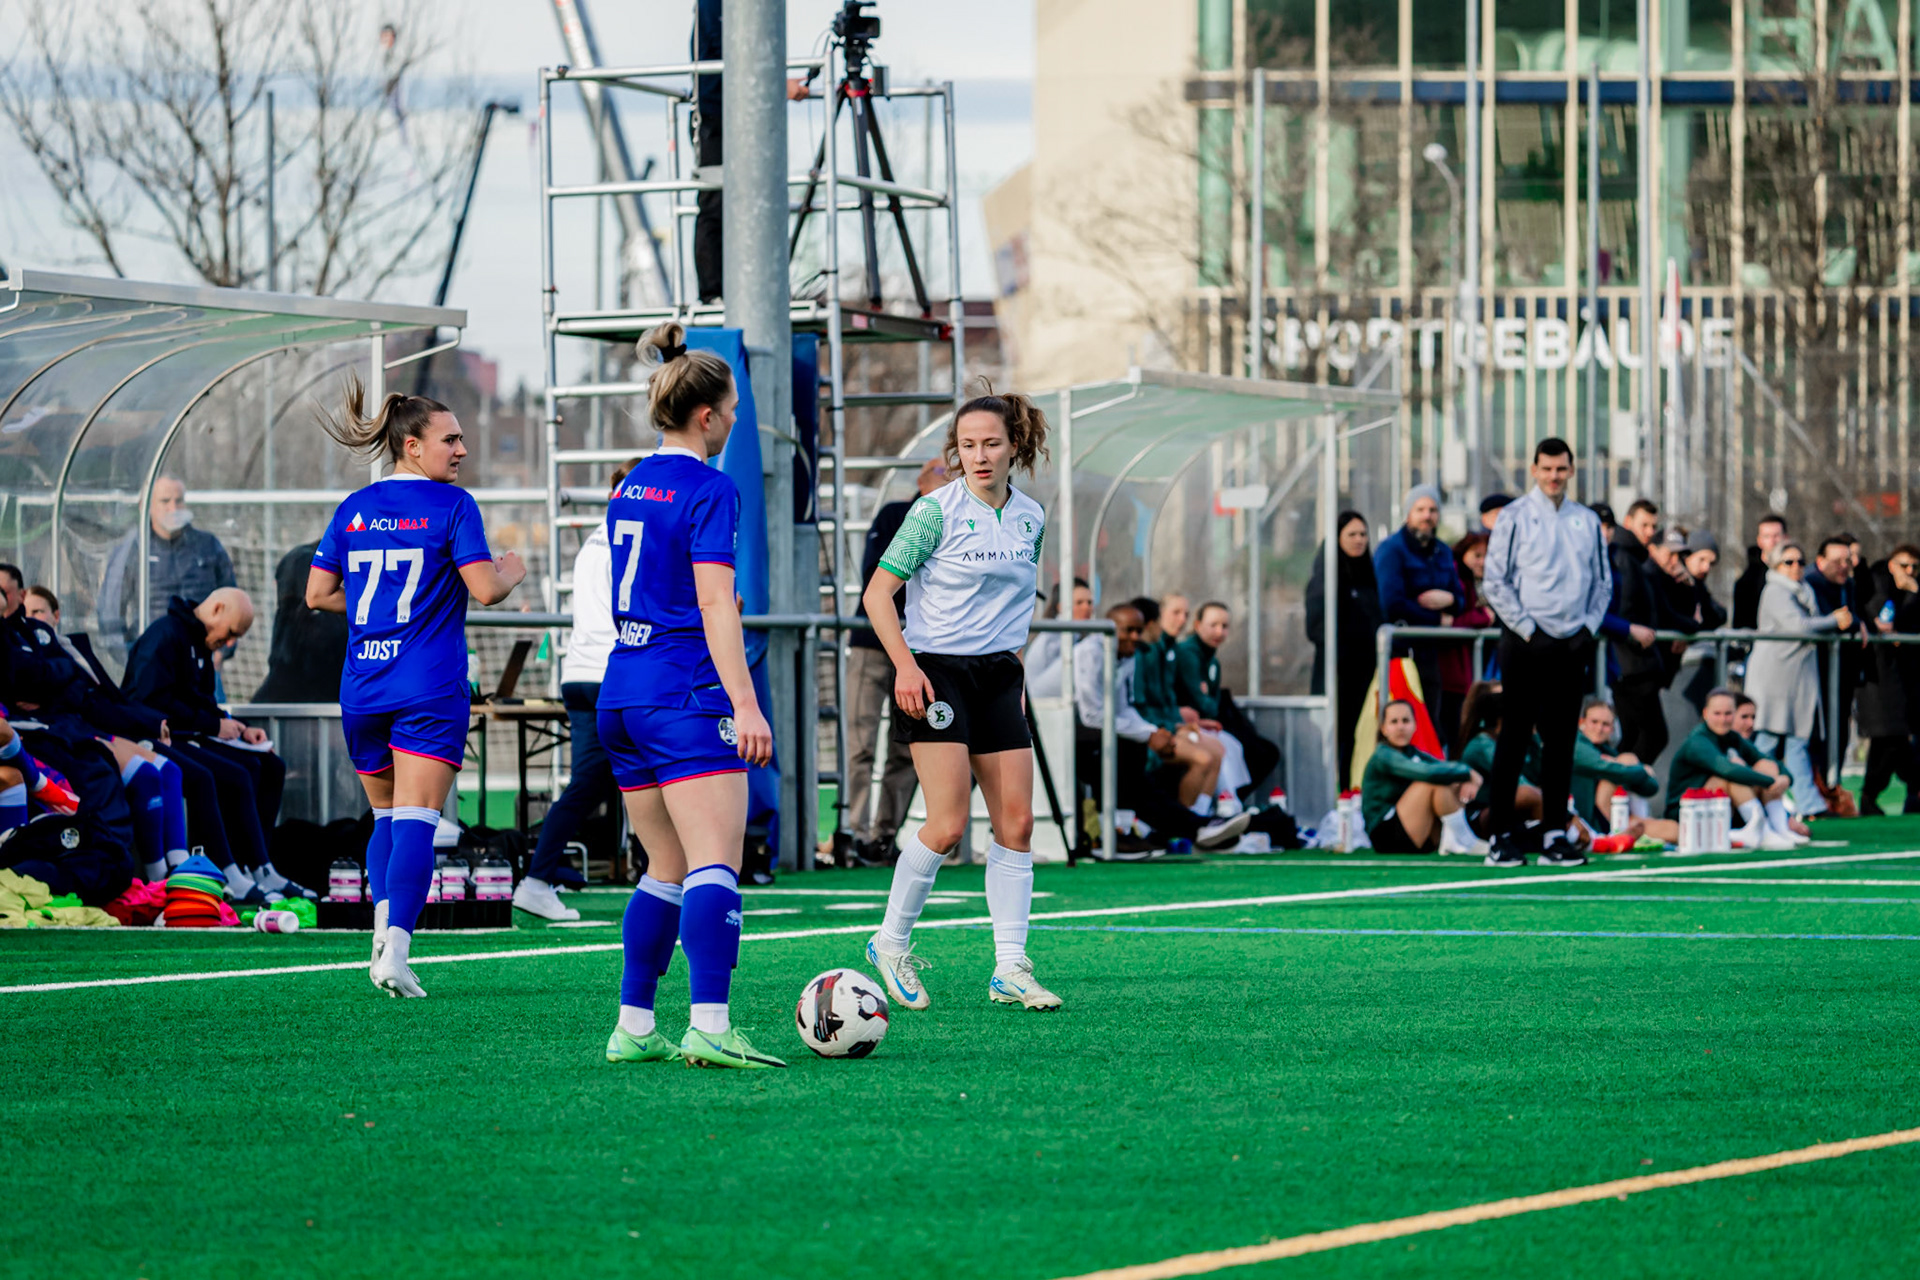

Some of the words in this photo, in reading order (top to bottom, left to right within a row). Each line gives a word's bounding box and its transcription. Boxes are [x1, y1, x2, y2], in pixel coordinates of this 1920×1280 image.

[622, 484, 677, 503] ACUMAX
[368, 517, 430, 531] ACUMAX
[612, 519, 645, 612] 7
[347, 547, 425, 625] 77
[619, 620, 653, 646] AGER
[357, 640, 402, 660] JOST
